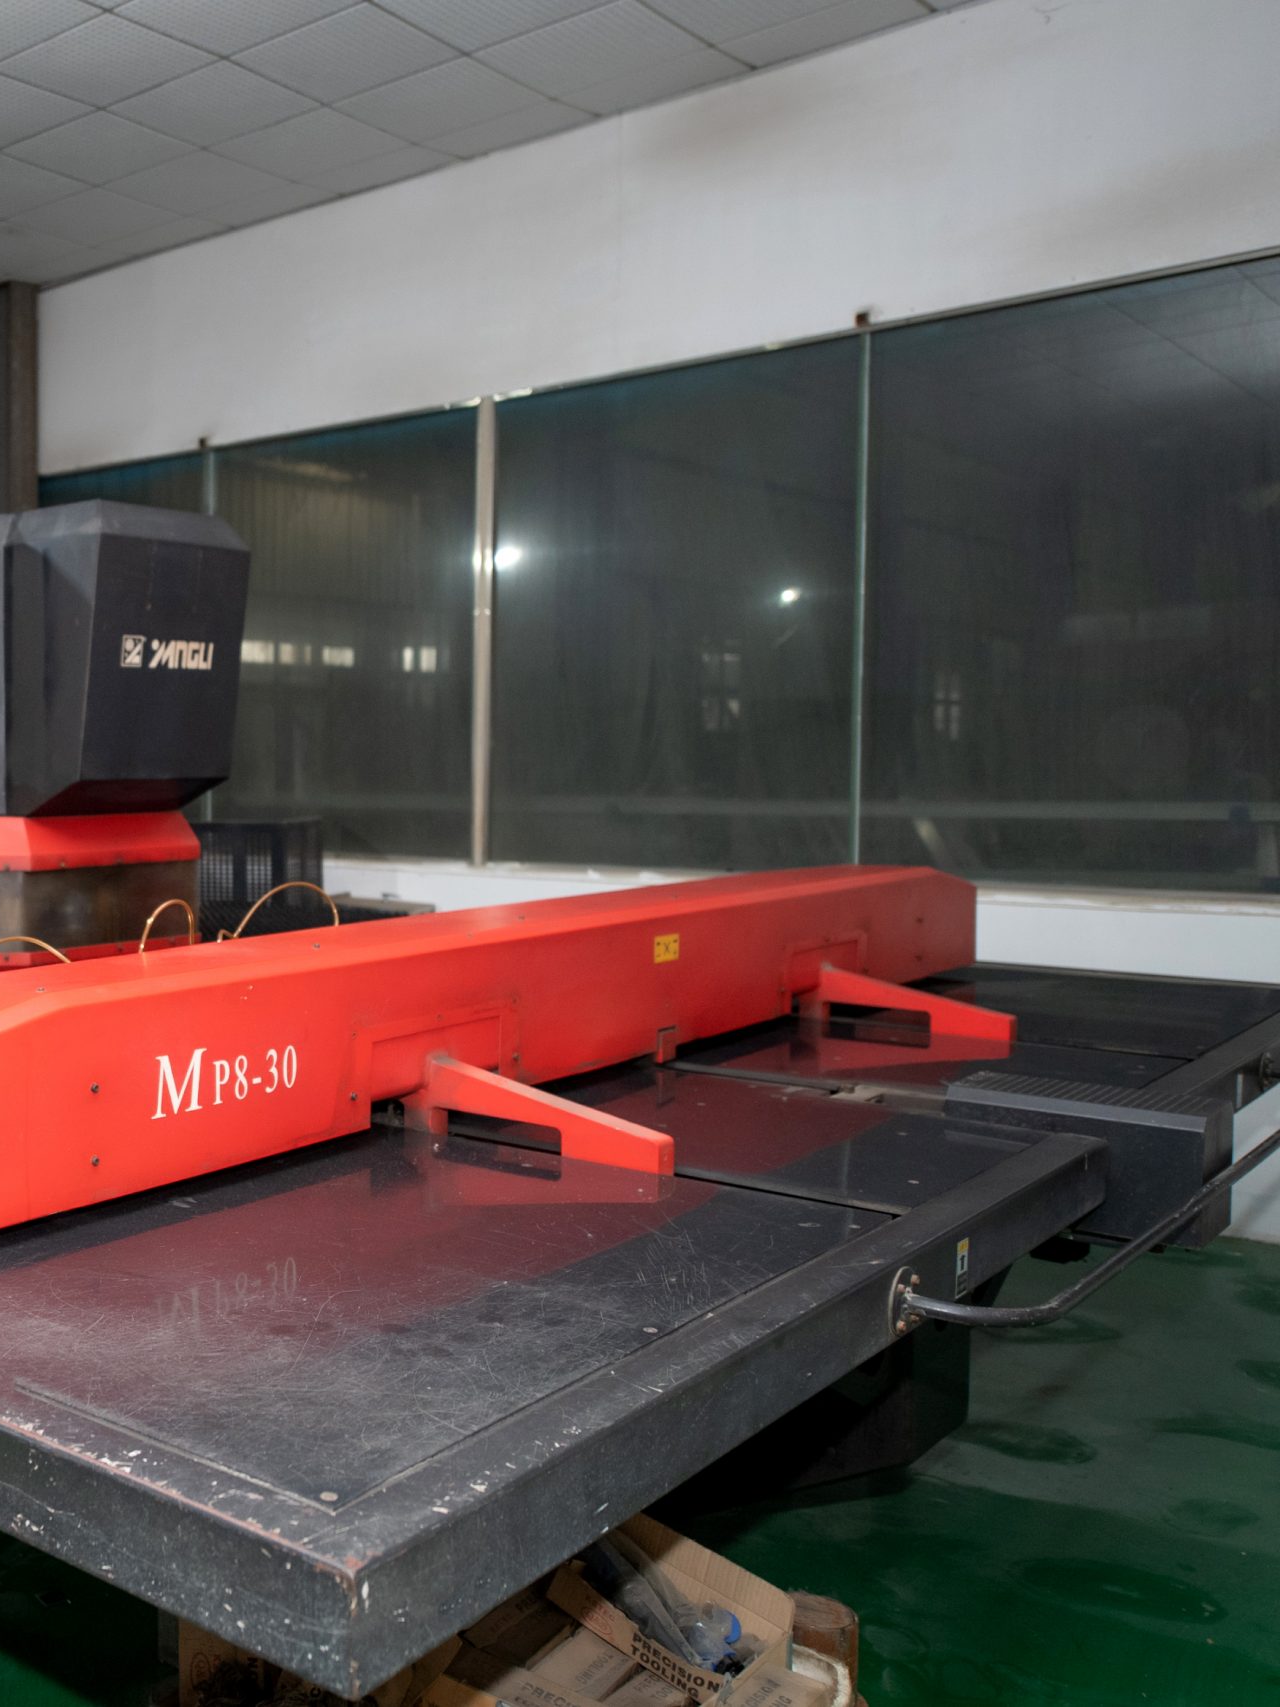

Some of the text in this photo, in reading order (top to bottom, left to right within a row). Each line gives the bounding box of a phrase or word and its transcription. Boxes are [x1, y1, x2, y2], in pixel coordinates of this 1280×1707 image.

[149, 639, 214, 670] YANGLI
[151, 1045, 297, 1120] MP8-30
[630, 1645, 699, 1699] TOOLING
[632, 1632, 721, 1693] PRECISION
